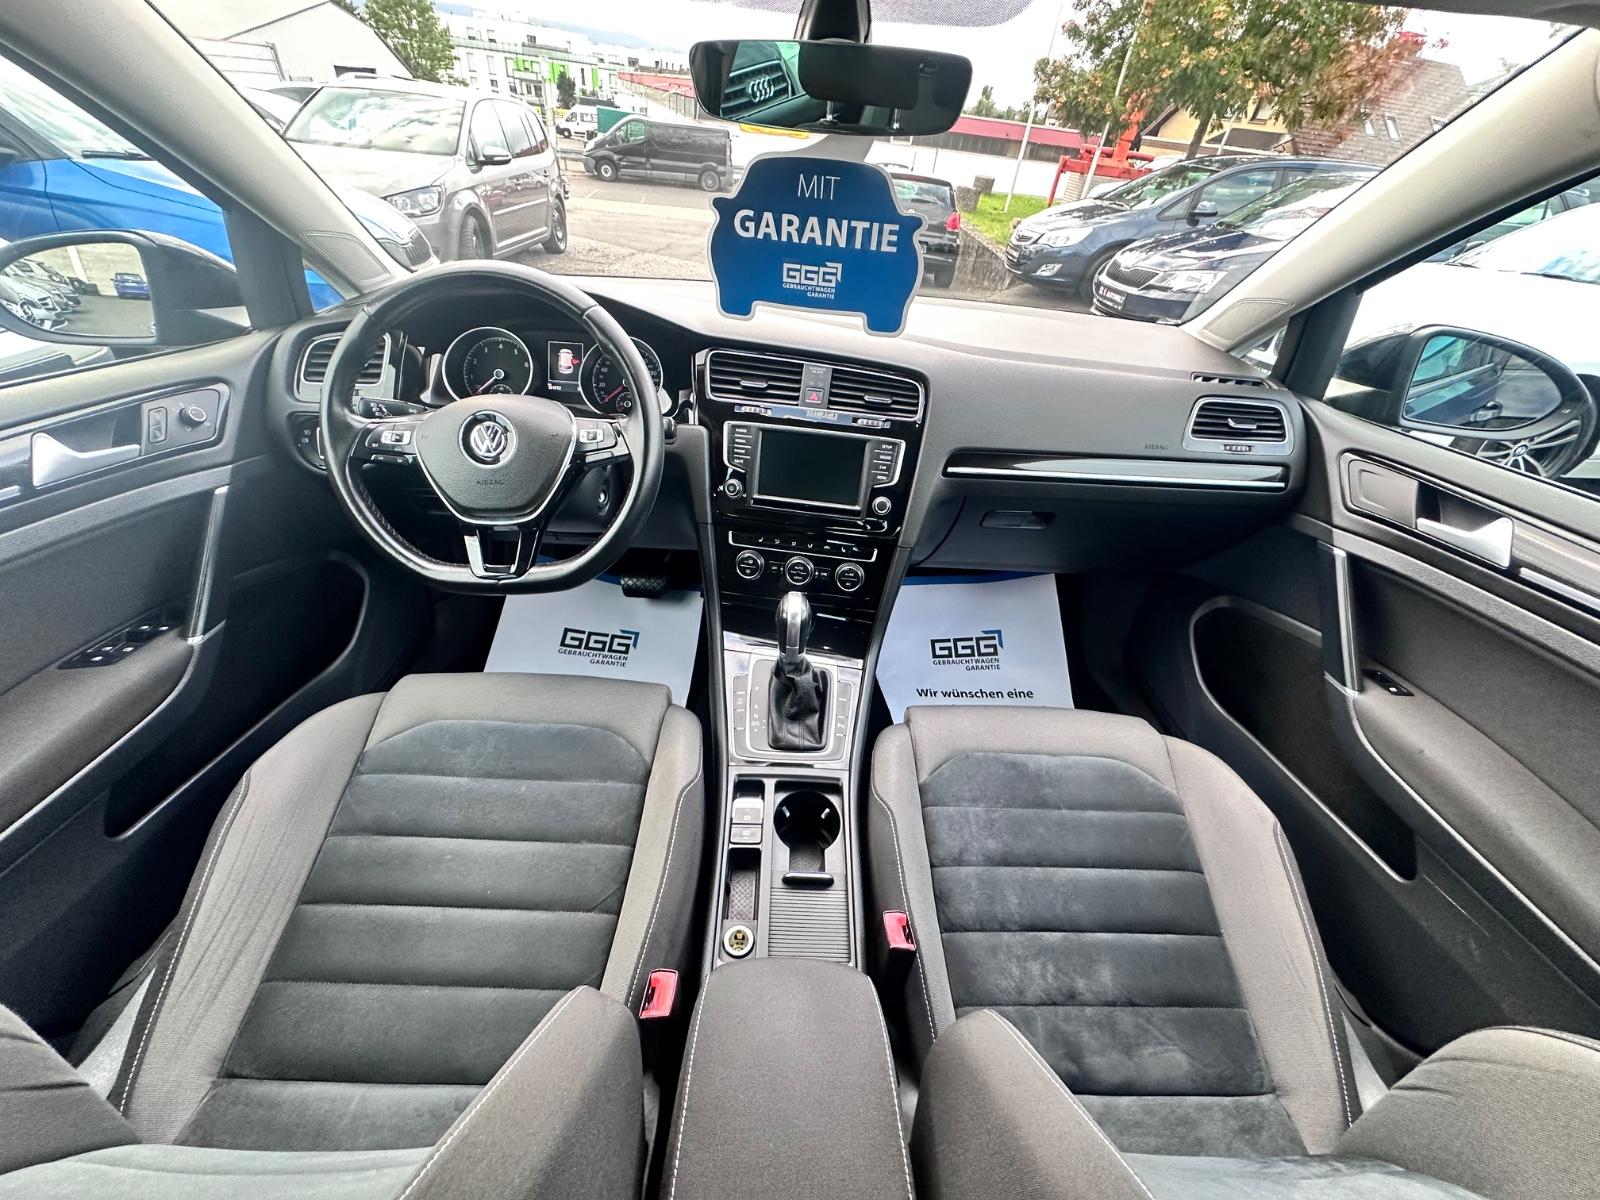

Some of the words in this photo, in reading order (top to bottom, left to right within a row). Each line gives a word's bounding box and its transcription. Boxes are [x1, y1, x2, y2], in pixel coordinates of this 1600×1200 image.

[798, 173, 840, 200] MIT
[733, 209, 900, 253] GARANTIE
[783, 263, 837, 287] GGG
[782, 282, 836, 293] GEBRAUCHTWAGEN
[807, 291, 835, 300] GARANTIE
[560, 627, 633, 655] GGG
[930, 635, 999, 659] GGG
[558, 648, 628, 661] GEBRAUCHTWAGEN
[589, 658, 627, 668] GARANTIE
[932, 657, 1000, 666] GEBRAUCHTWAGEN
[916, 688, 938, 698] Wir
[941, 688, 1004, 699] wünschen
[1008, 688, 1034, 699] eine
